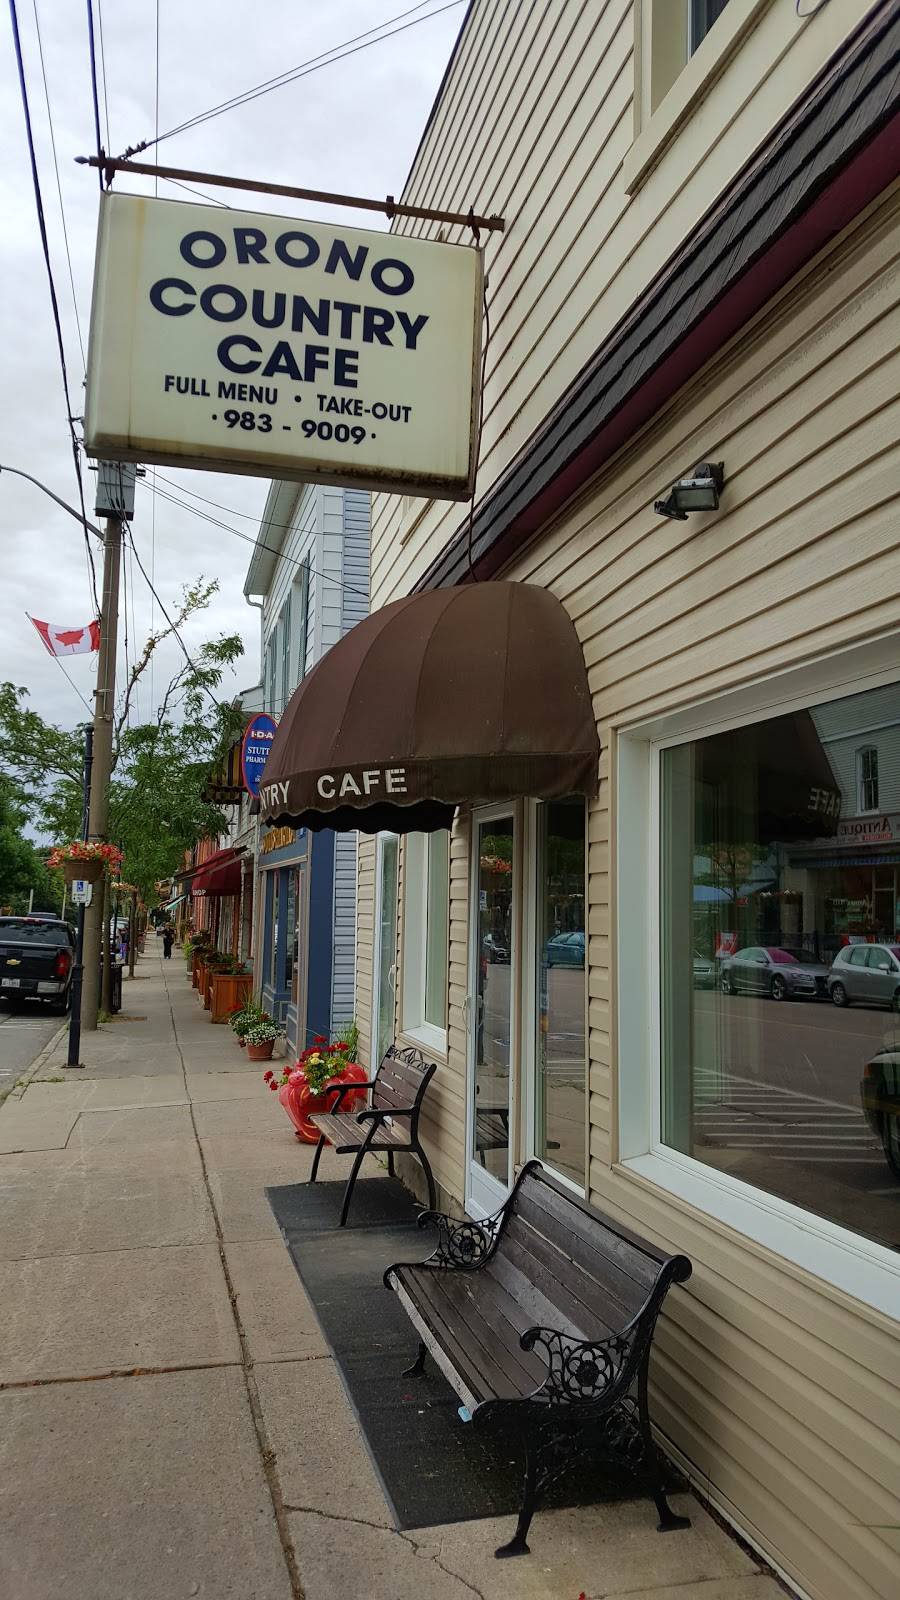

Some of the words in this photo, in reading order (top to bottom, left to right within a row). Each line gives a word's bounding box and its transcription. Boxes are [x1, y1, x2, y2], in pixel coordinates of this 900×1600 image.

[179, 227, 415, 296] ORONO
[149, 277, 429, 350] COUNTRY
[217, 334, 359, 388] CAFE
[164, 375, 210, 397] FULL
[217, 381, 278, 405] MENU
[317, 394, 412, 423] TAKE-OUT
[317, 768, 408, 799] CAFE
